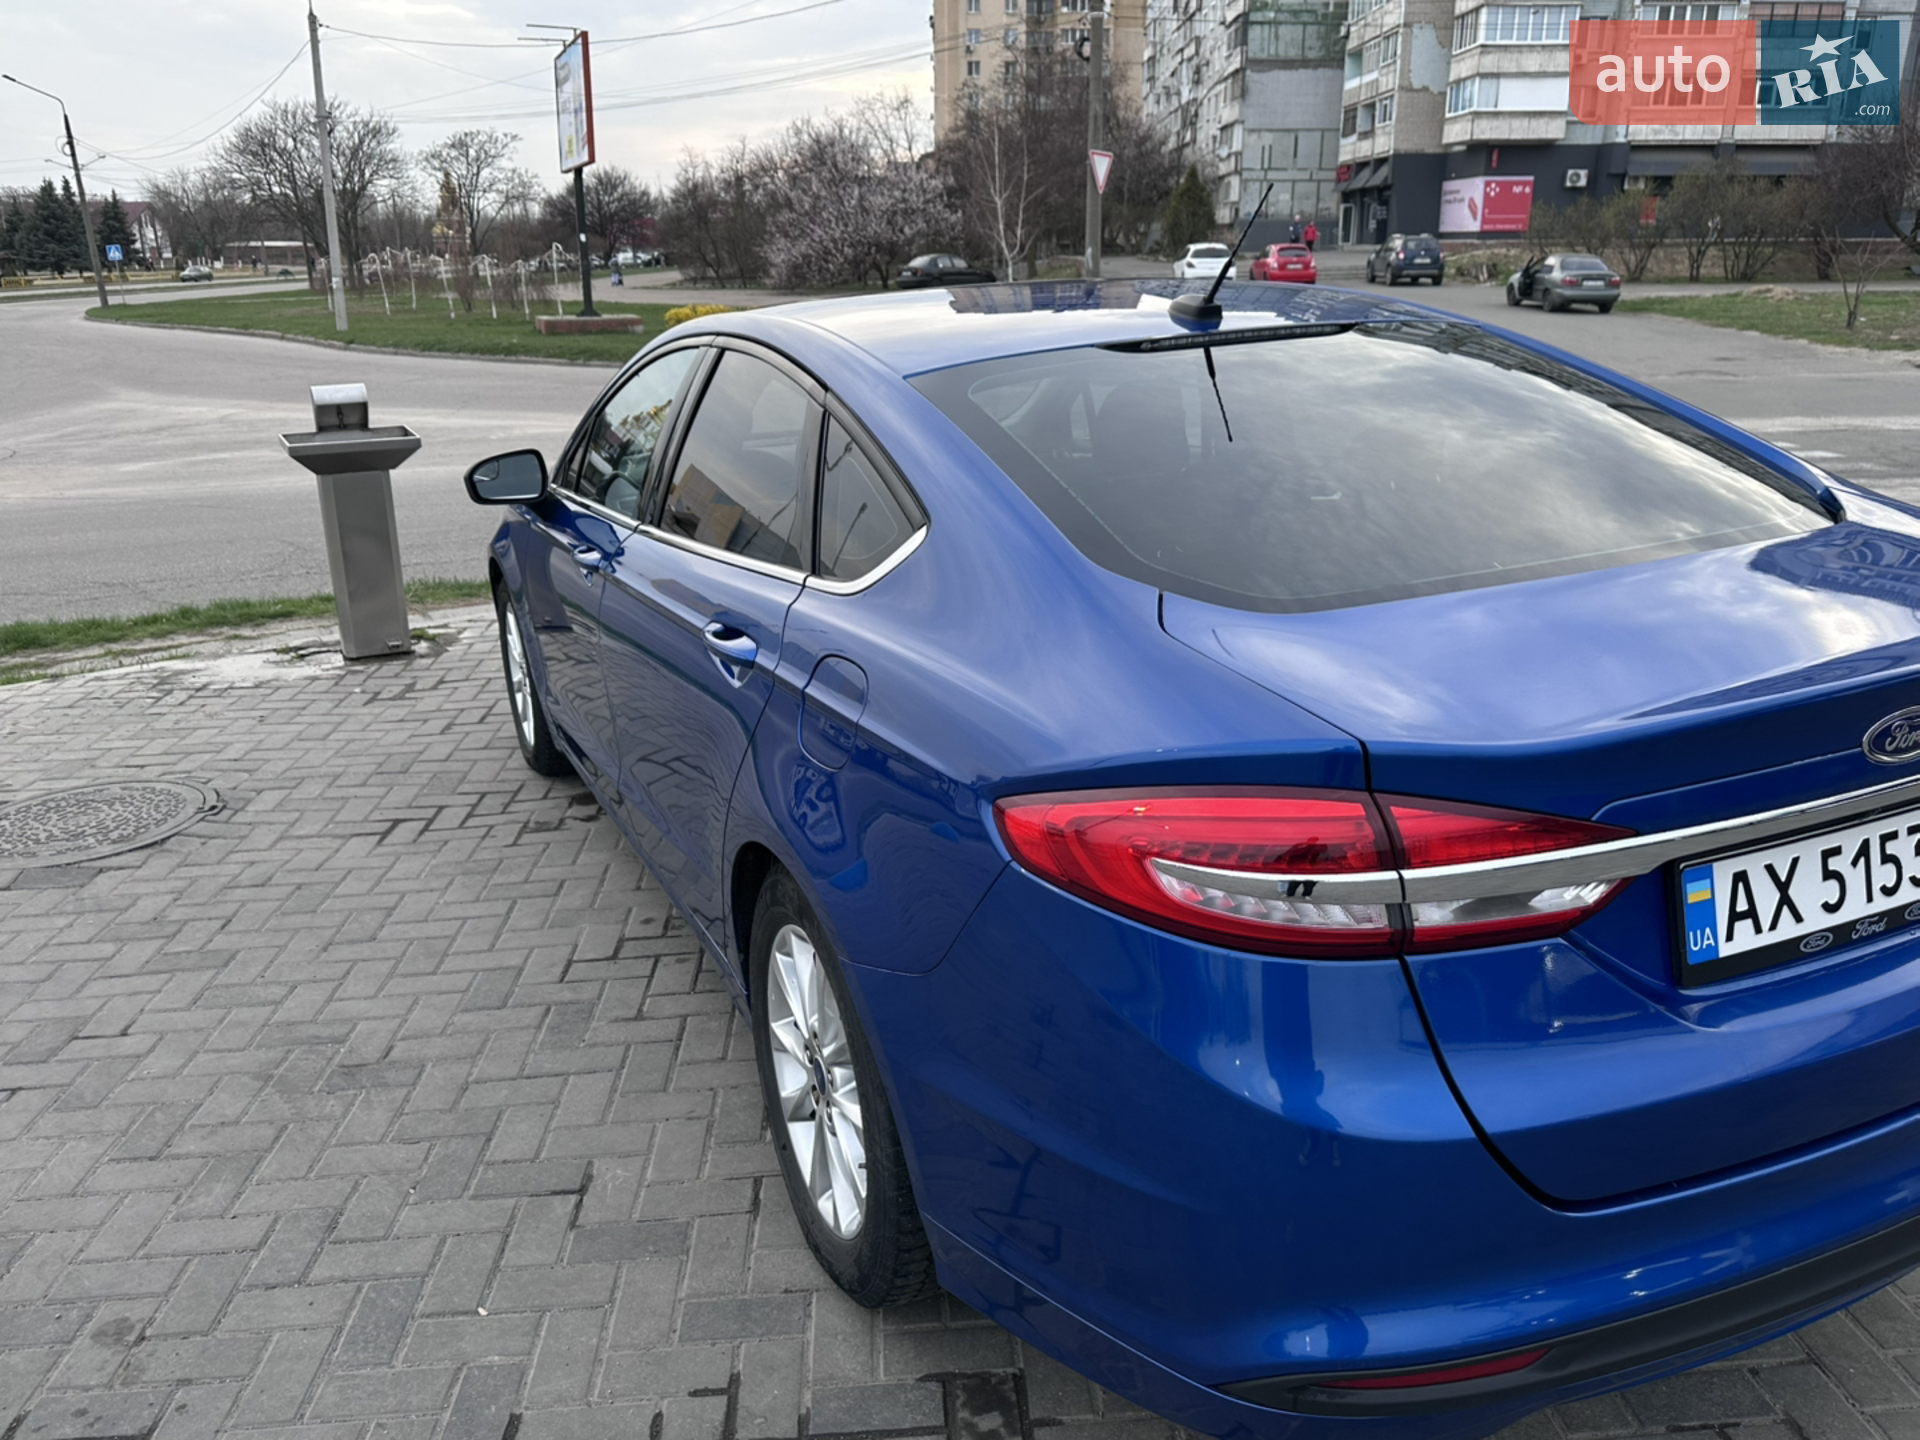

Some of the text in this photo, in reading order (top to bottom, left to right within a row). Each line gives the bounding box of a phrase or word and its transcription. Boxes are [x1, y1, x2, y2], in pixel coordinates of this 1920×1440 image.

[1725, 855, 1805, 943] AX
[1689, 926, 1716, 951] UA
[1851, 915, 1888, 940] Ford
